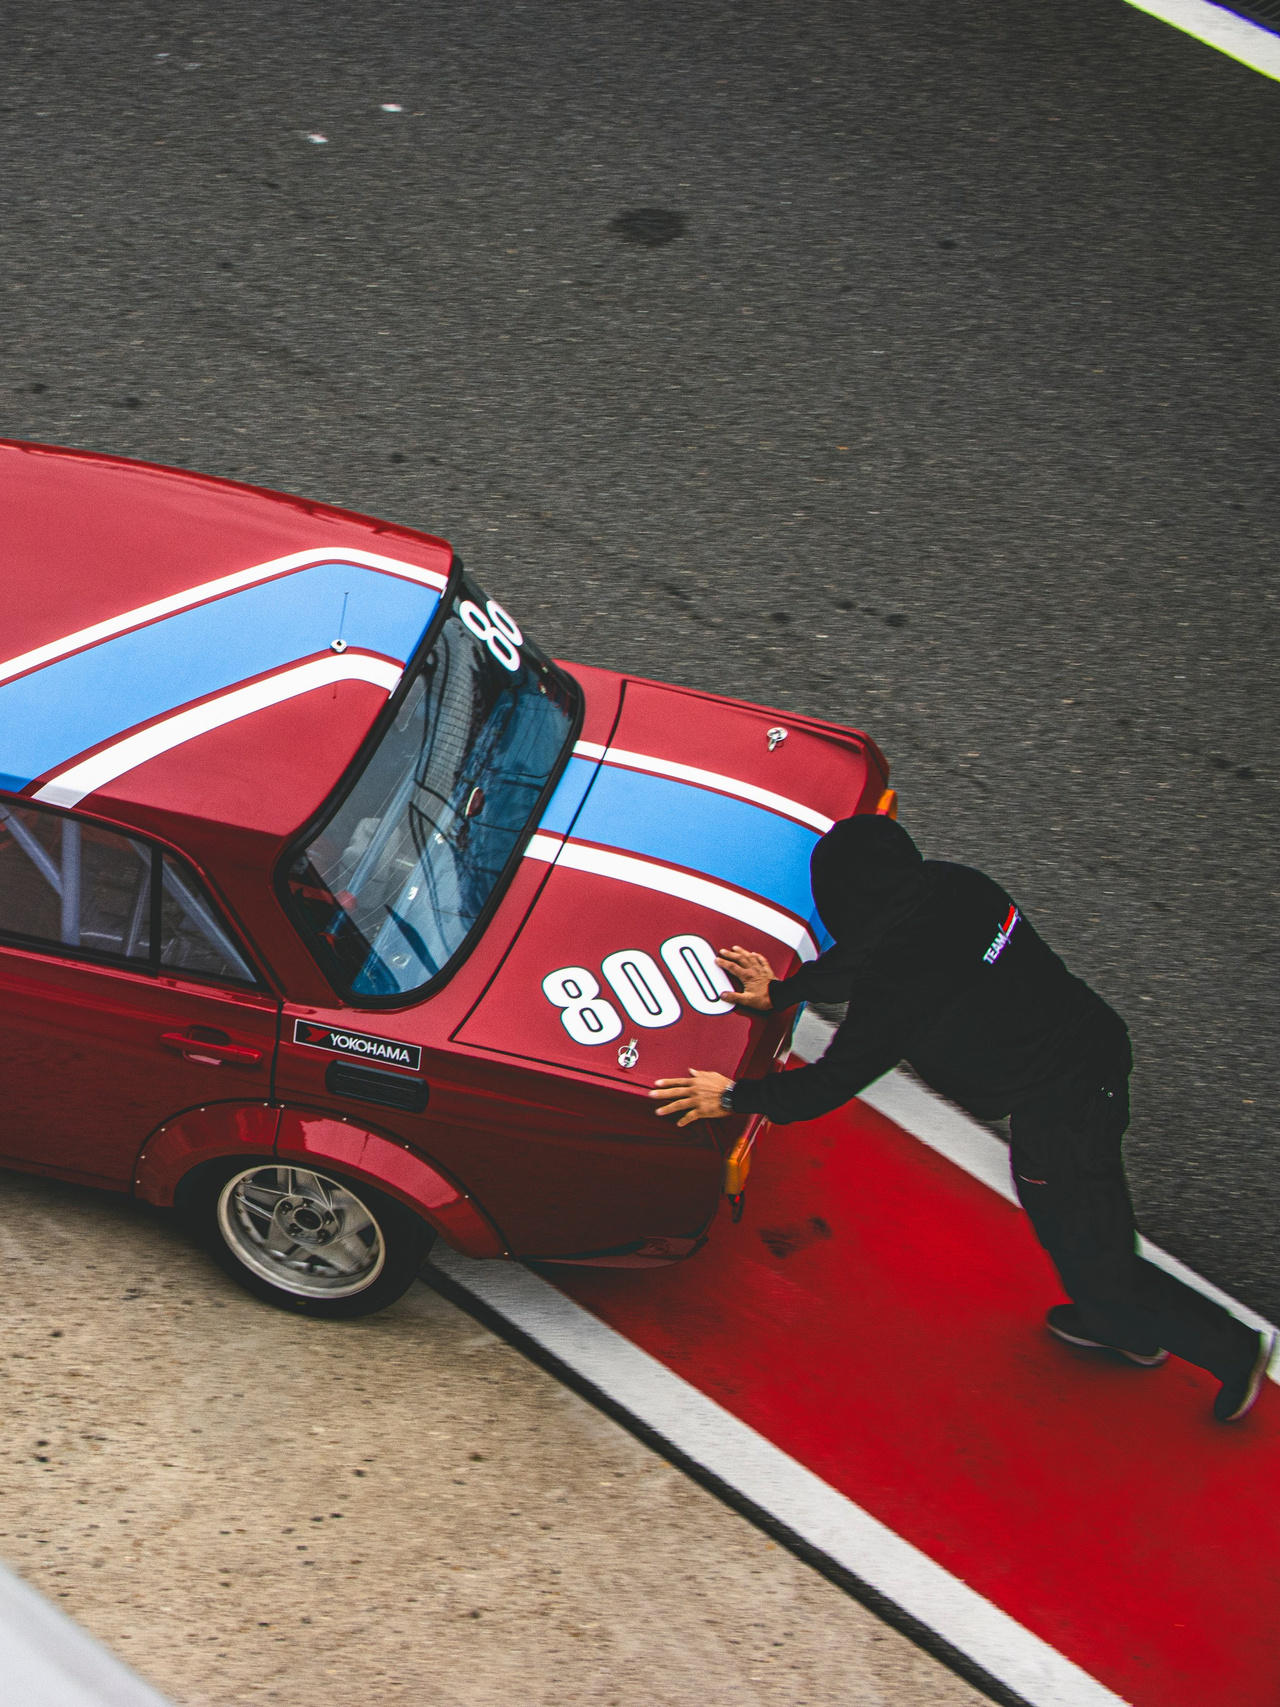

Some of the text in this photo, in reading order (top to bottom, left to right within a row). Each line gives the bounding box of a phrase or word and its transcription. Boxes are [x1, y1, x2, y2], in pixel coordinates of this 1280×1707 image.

[982, 931, 1008, 965] TEAM
[541, 933, 737, 1046] 800
[330, 1033, 410, 1063] YOKOHAMA
